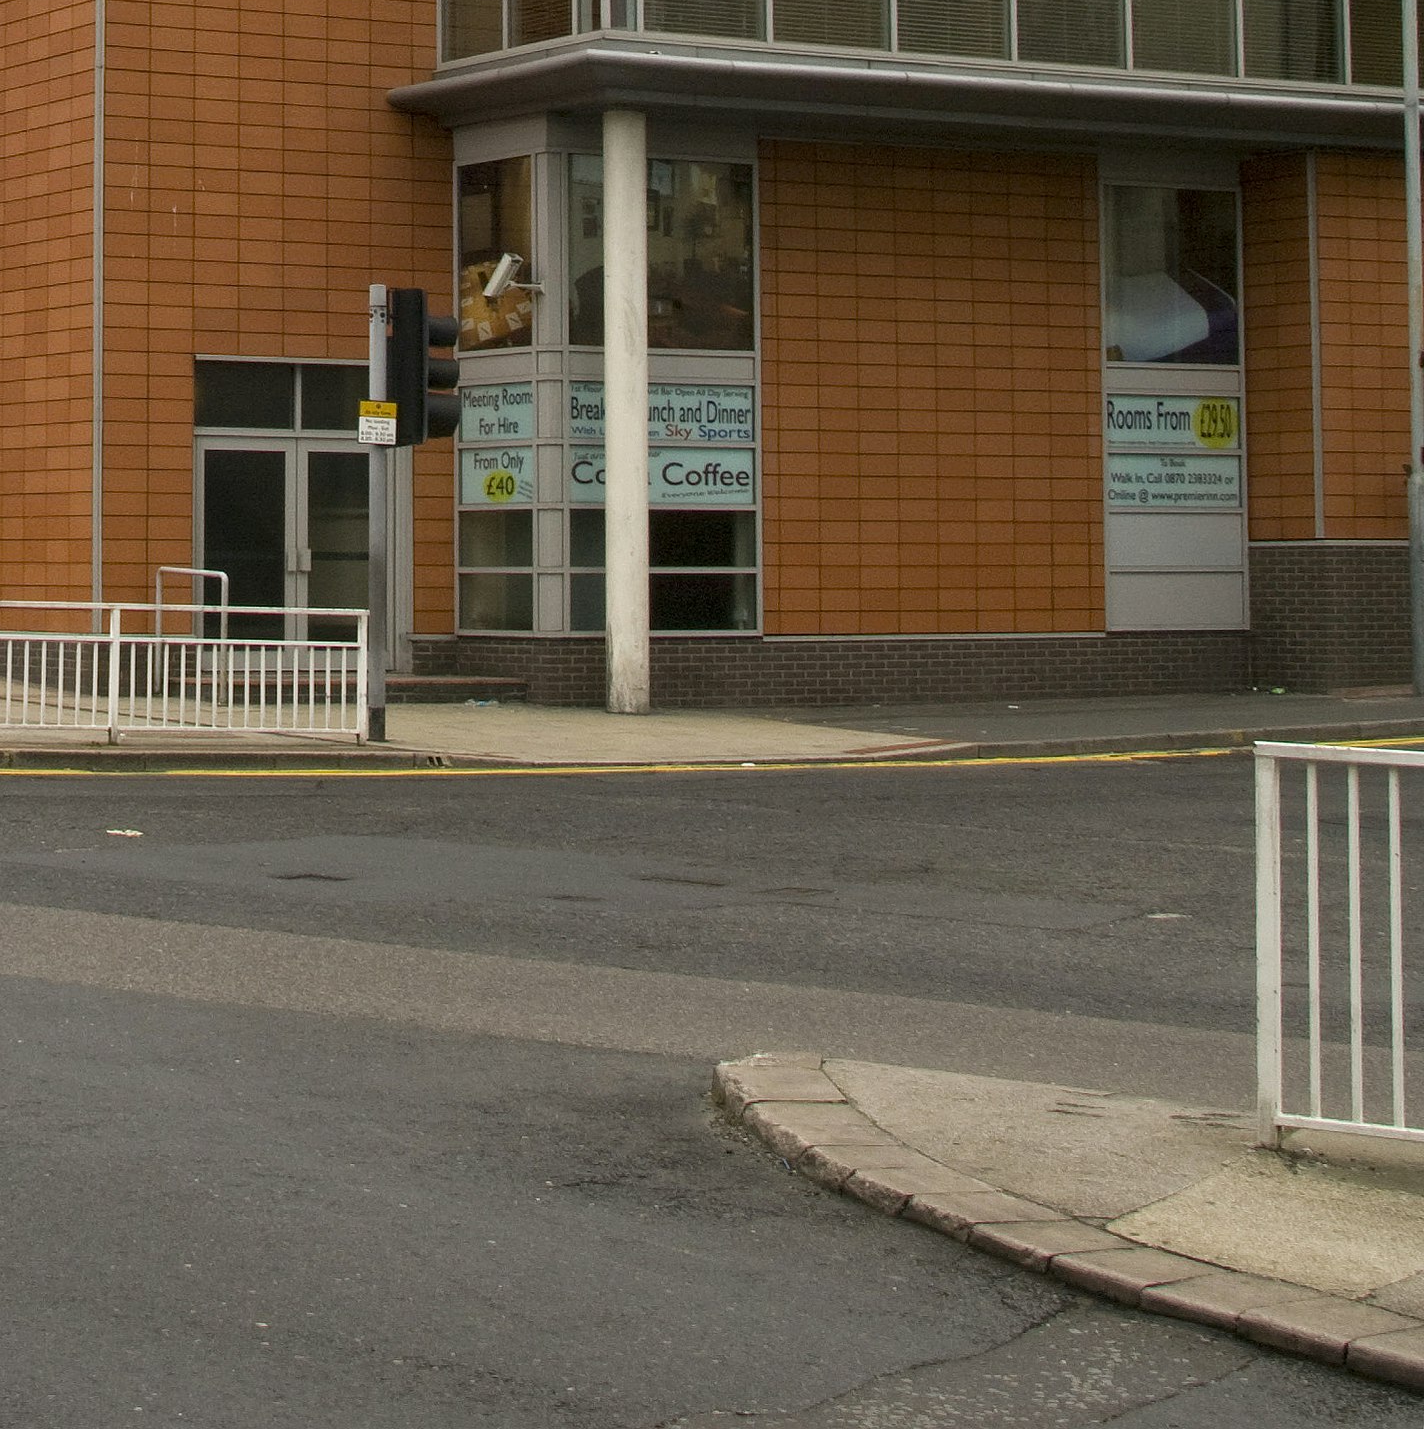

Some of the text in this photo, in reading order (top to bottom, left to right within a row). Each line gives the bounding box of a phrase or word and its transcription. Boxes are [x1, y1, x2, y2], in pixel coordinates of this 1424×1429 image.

[463, 390, 500, 412] Meeting
[675, 388, 695, 398] Open
[647, 399, 675, 423] unch
[679, 401, 702, 423] and
[706, 400, 751, 425] Dinner
[1106, 400, 1153, 430] Rooms
[1156, 401, 1191, 431] From
[479, 417, 519, 436] For Hire
[571, 426, 597, 435] With
[665, 423, 693, 440] Sky
[698, 424, 751, 441] Sports
[473, 451, 525, 474] From Only
[661, 461, 750, 487] Coffee
[1110, 472, 1133, 483] Walk
[1146, 472, 1163, 484] Call
[1164, 472, 1185, 484] 0870
[1224, 475, 1235, 485] or
[486, 475, 515, 496] £40
[1107, 488, 1136, 500] Online
[1138, 488, 1149, 503] @
